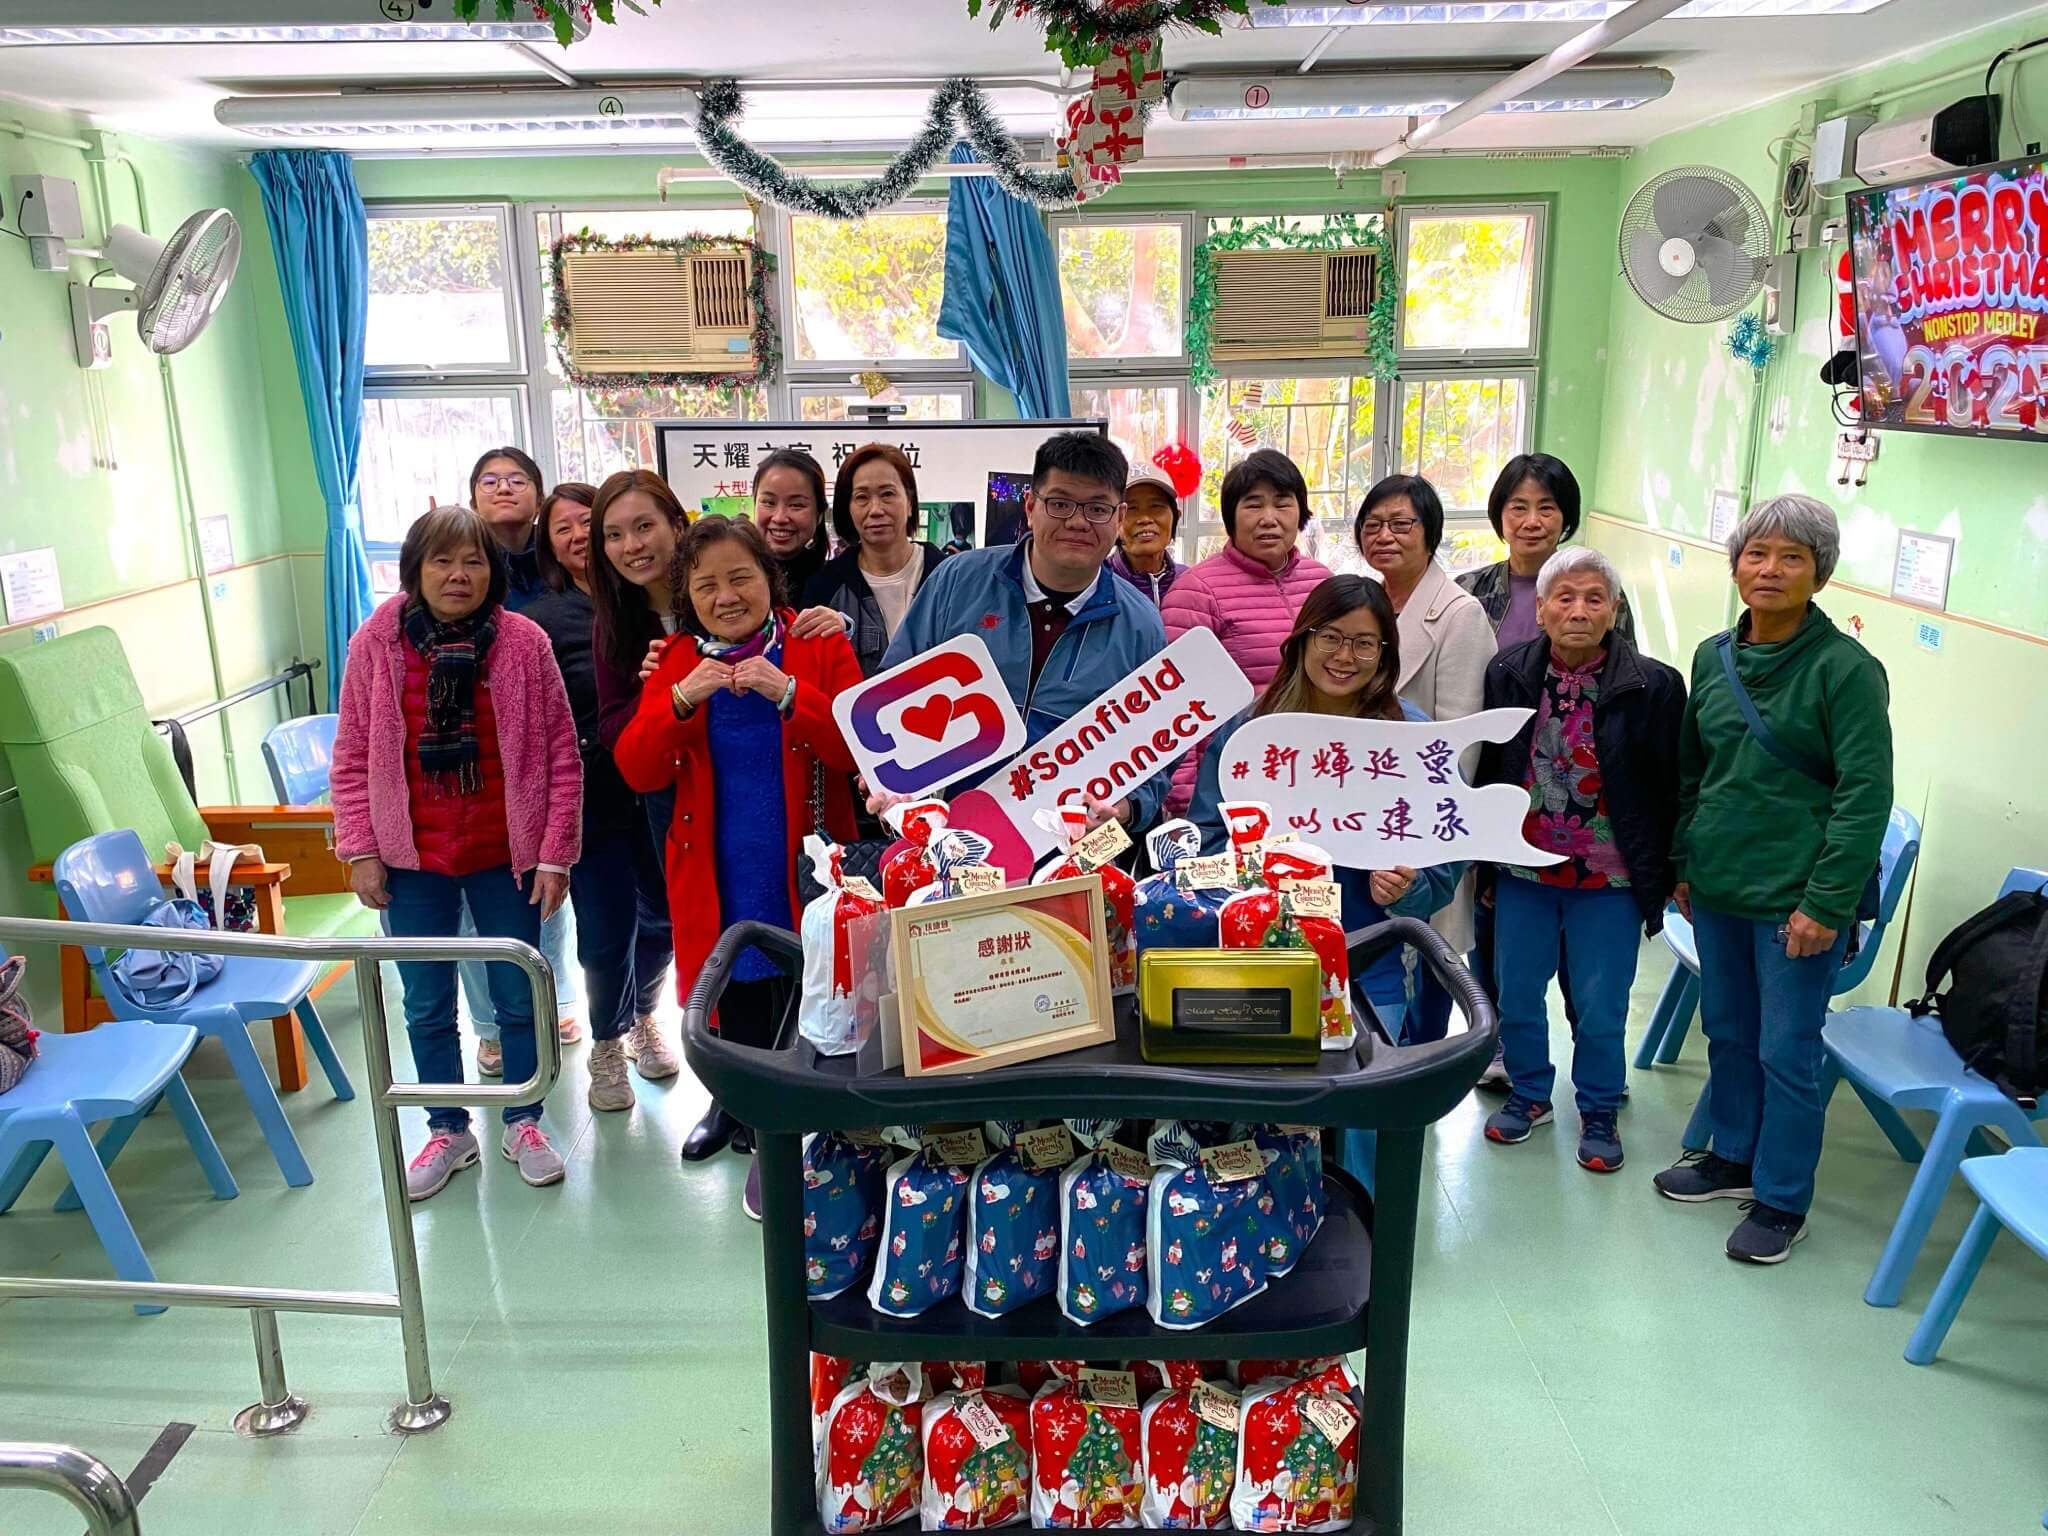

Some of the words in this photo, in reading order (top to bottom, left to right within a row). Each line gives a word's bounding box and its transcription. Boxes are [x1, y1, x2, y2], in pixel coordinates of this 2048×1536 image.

[1895, 187, 2048, 273] MERRY
[1923, 312, 1980, 343] NONSTOP
[1984, 309, 2039, 339] MEDLEY
[1009, 658, 1185, 801] #Sanfield
[1288, 797, 1470, 841] 以心建家
[978, 930, 1032, 958] 感謝狀
